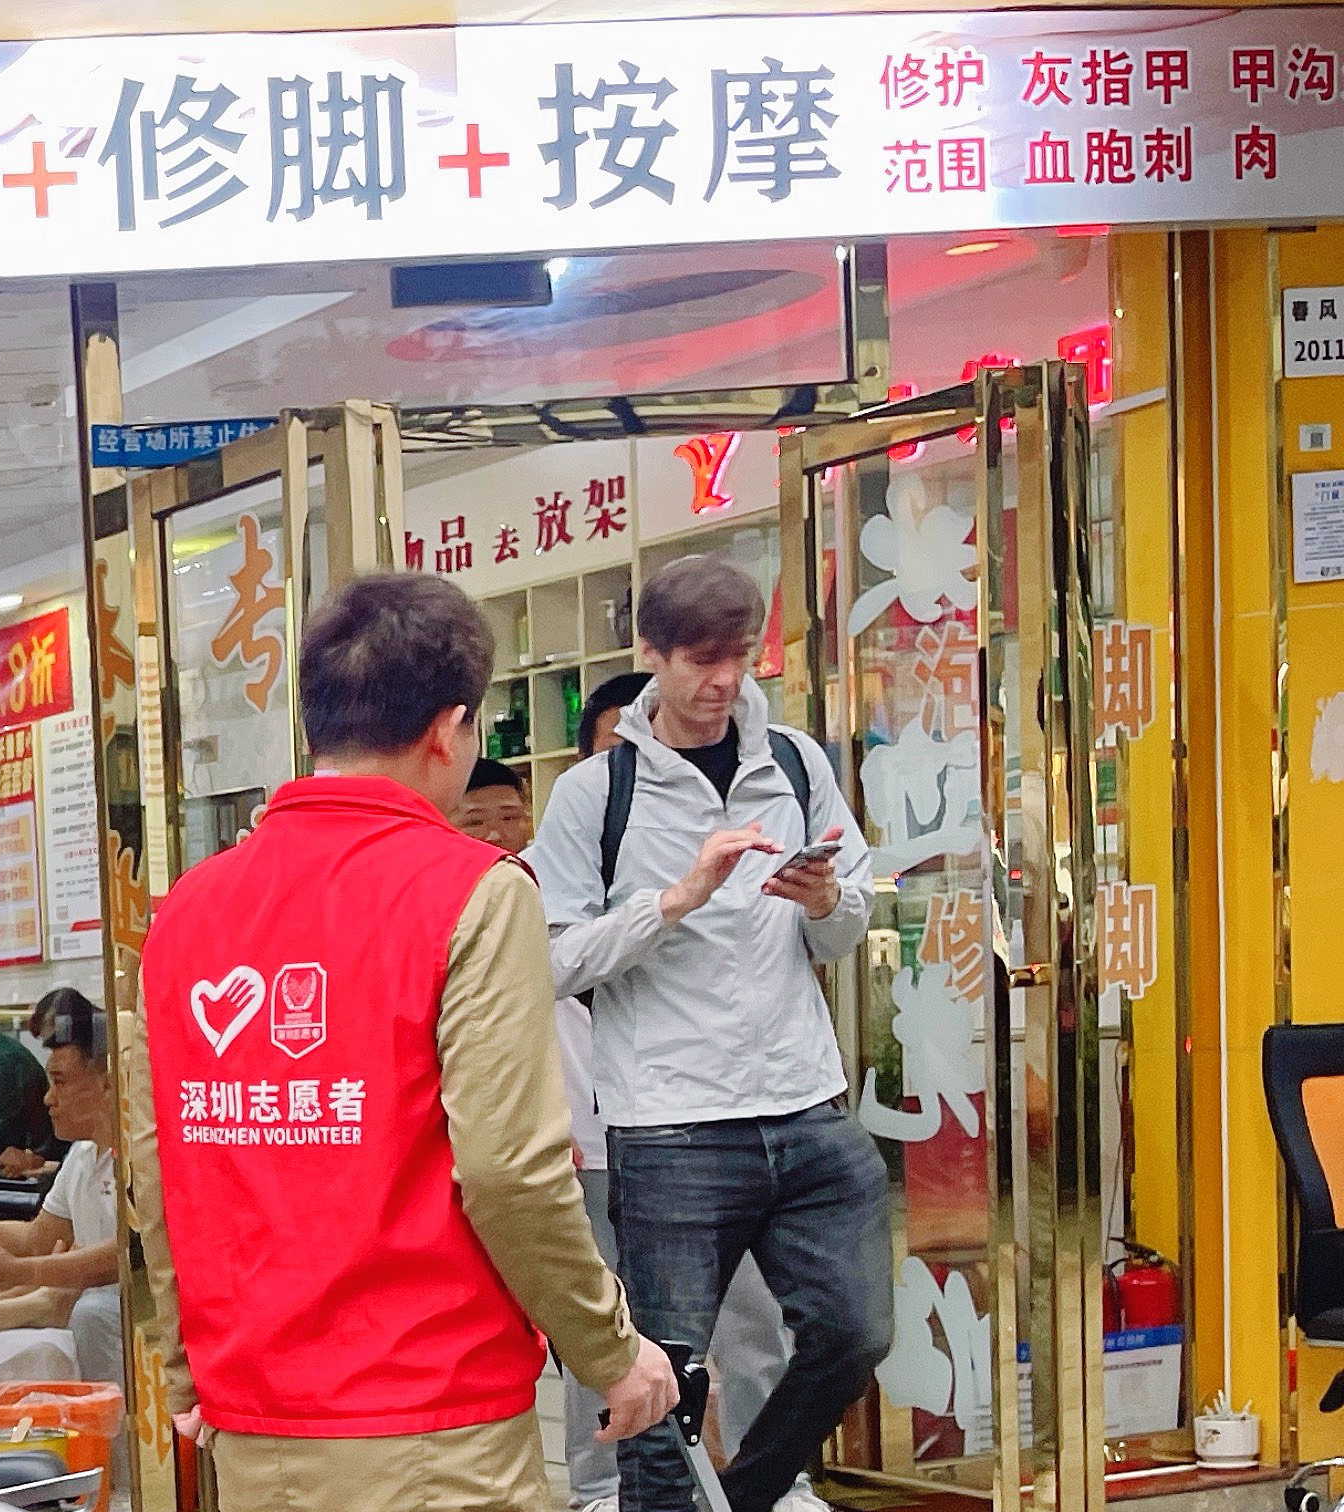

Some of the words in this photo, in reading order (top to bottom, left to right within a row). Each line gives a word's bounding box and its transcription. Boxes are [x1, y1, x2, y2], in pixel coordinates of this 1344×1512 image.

[880, 51, 985, 108] 修护
[1021, 49, 1189, 106] 灰指甲
[884, 137, 986, 193] 范围
[1024, 126, 1192, 184] 血胞刺
[1235, 124, 1278, 180] 肉
[1294, 339, 1344, 361] 2011
[97, 422, 275, 453] 经营场所禁止住
[179, 1078, 367, 1122] 深圳志愿者
[182, 1125, 261, 1145] SHENZHEN
[263, 1126, 362, 1146] VOLUNTEER
